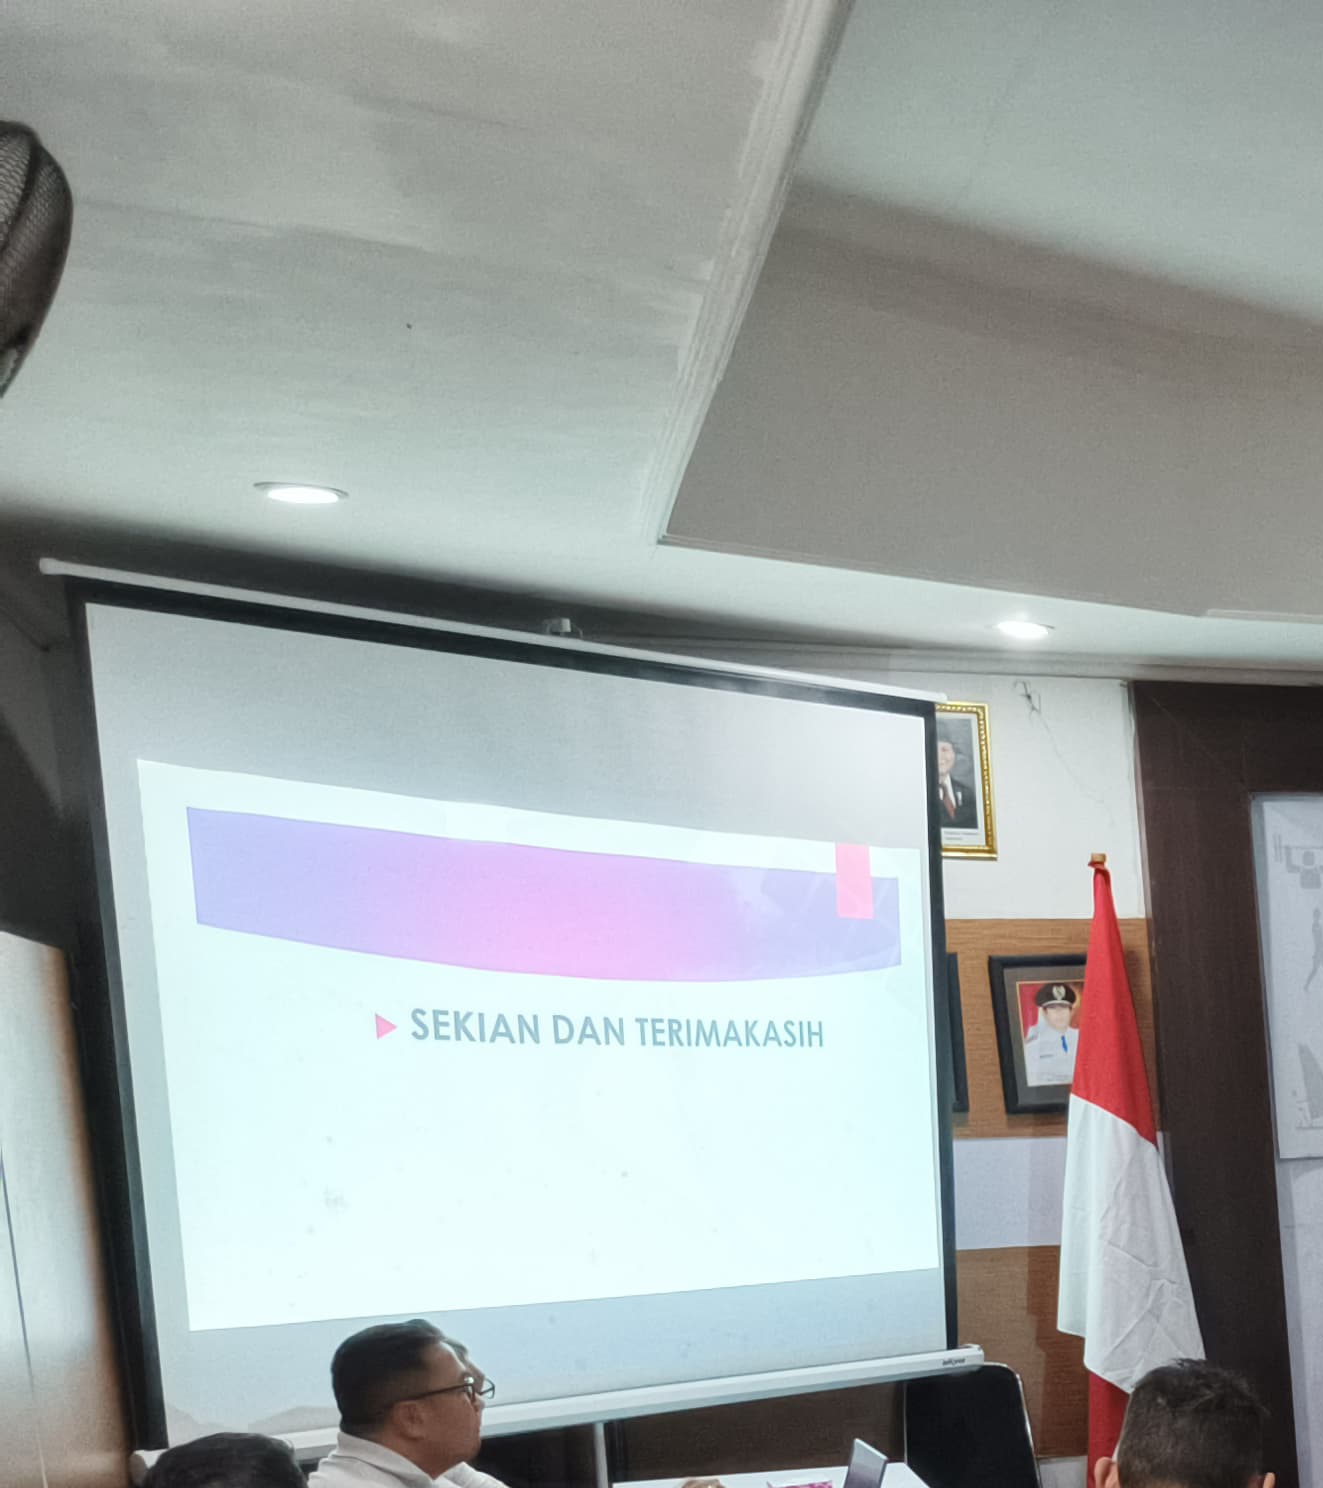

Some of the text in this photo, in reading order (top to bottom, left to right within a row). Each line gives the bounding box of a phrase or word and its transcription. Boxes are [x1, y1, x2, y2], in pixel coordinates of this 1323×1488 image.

[410, 1007, 825, 1049] SEKIAN DAN TERIMAKASIH
